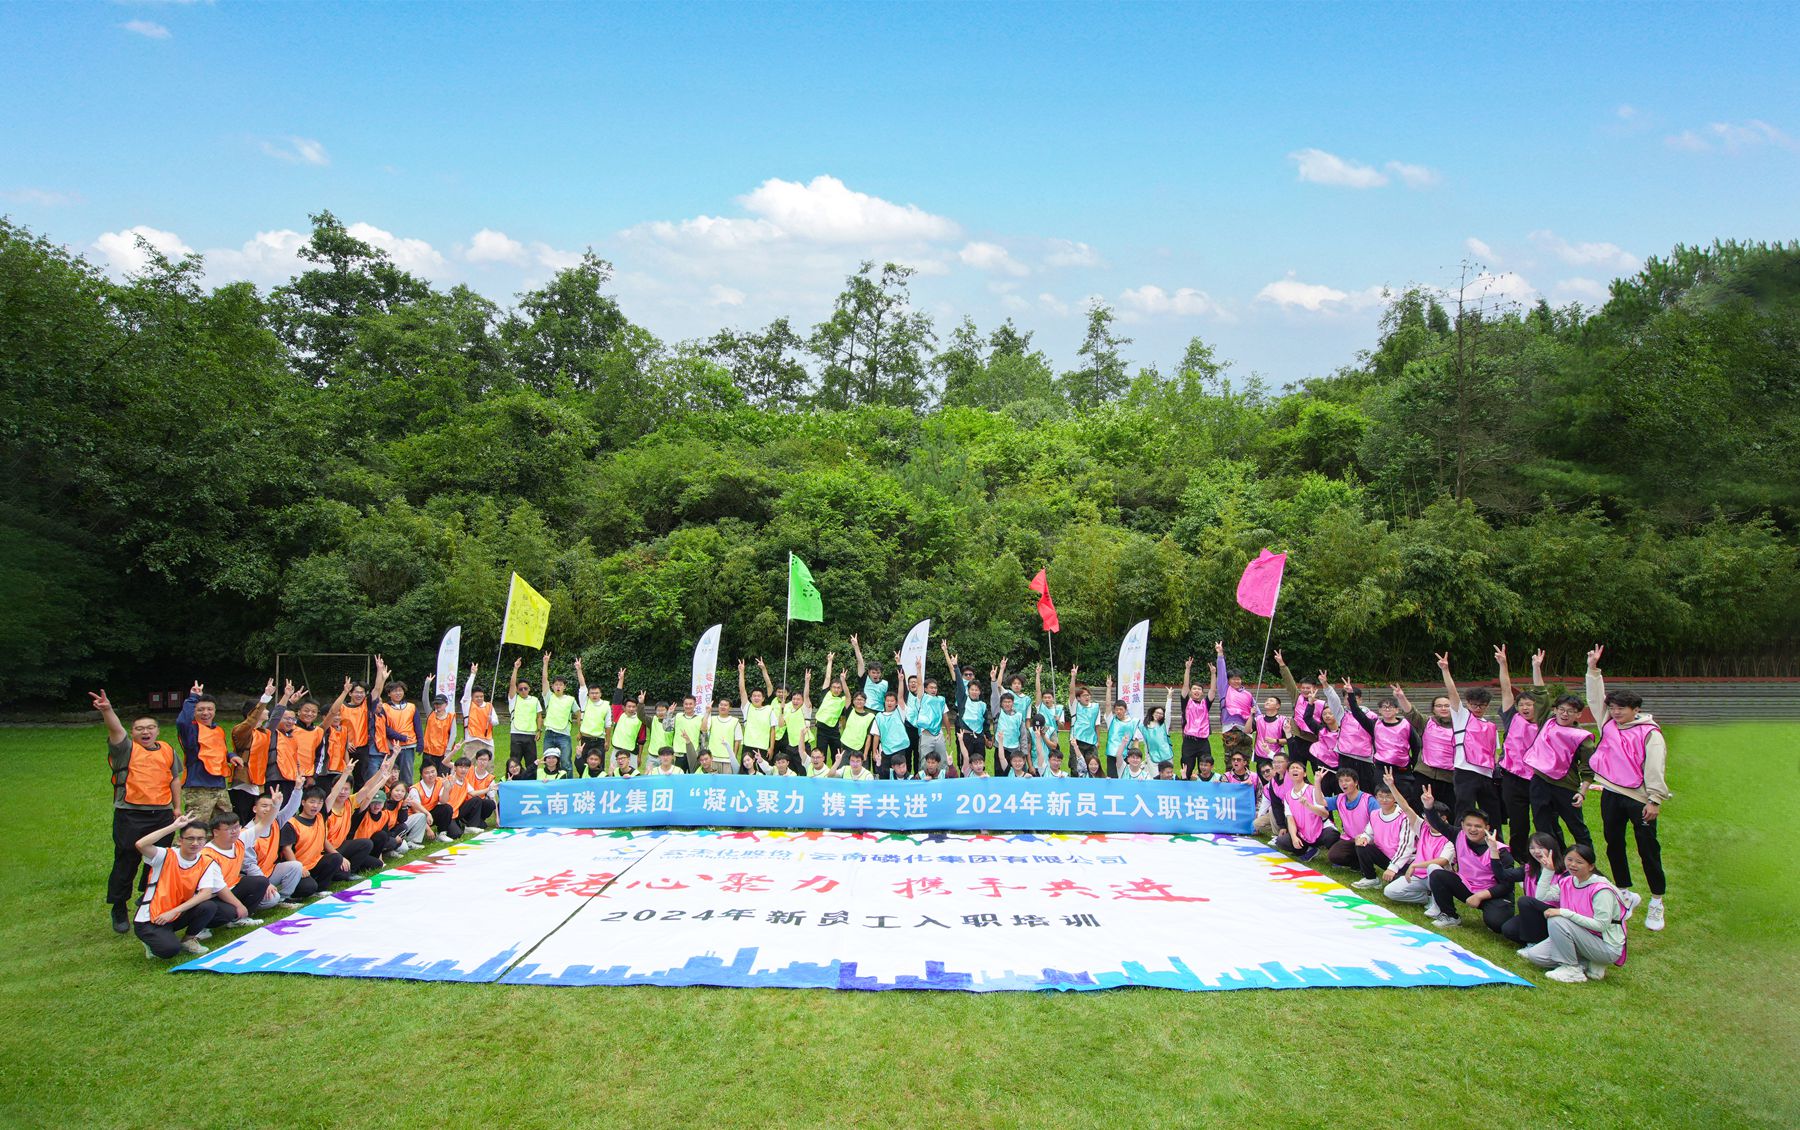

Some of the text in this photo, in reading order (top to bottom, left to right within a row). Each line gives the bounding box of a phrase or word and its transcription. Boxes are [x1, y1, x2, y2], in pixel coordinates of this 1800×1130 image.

[519, 788, 674, 816] 云南磷化集团
[956, 791, 1238, 821] 2024年新员工入职培训
[809, 852, 1128, 865] 云南磷化集团有限公司
[505, 869, 1210, 903] 凝心聚力 携手共进
[600, 908, 1102, 929] 2024年新员工入职培训
